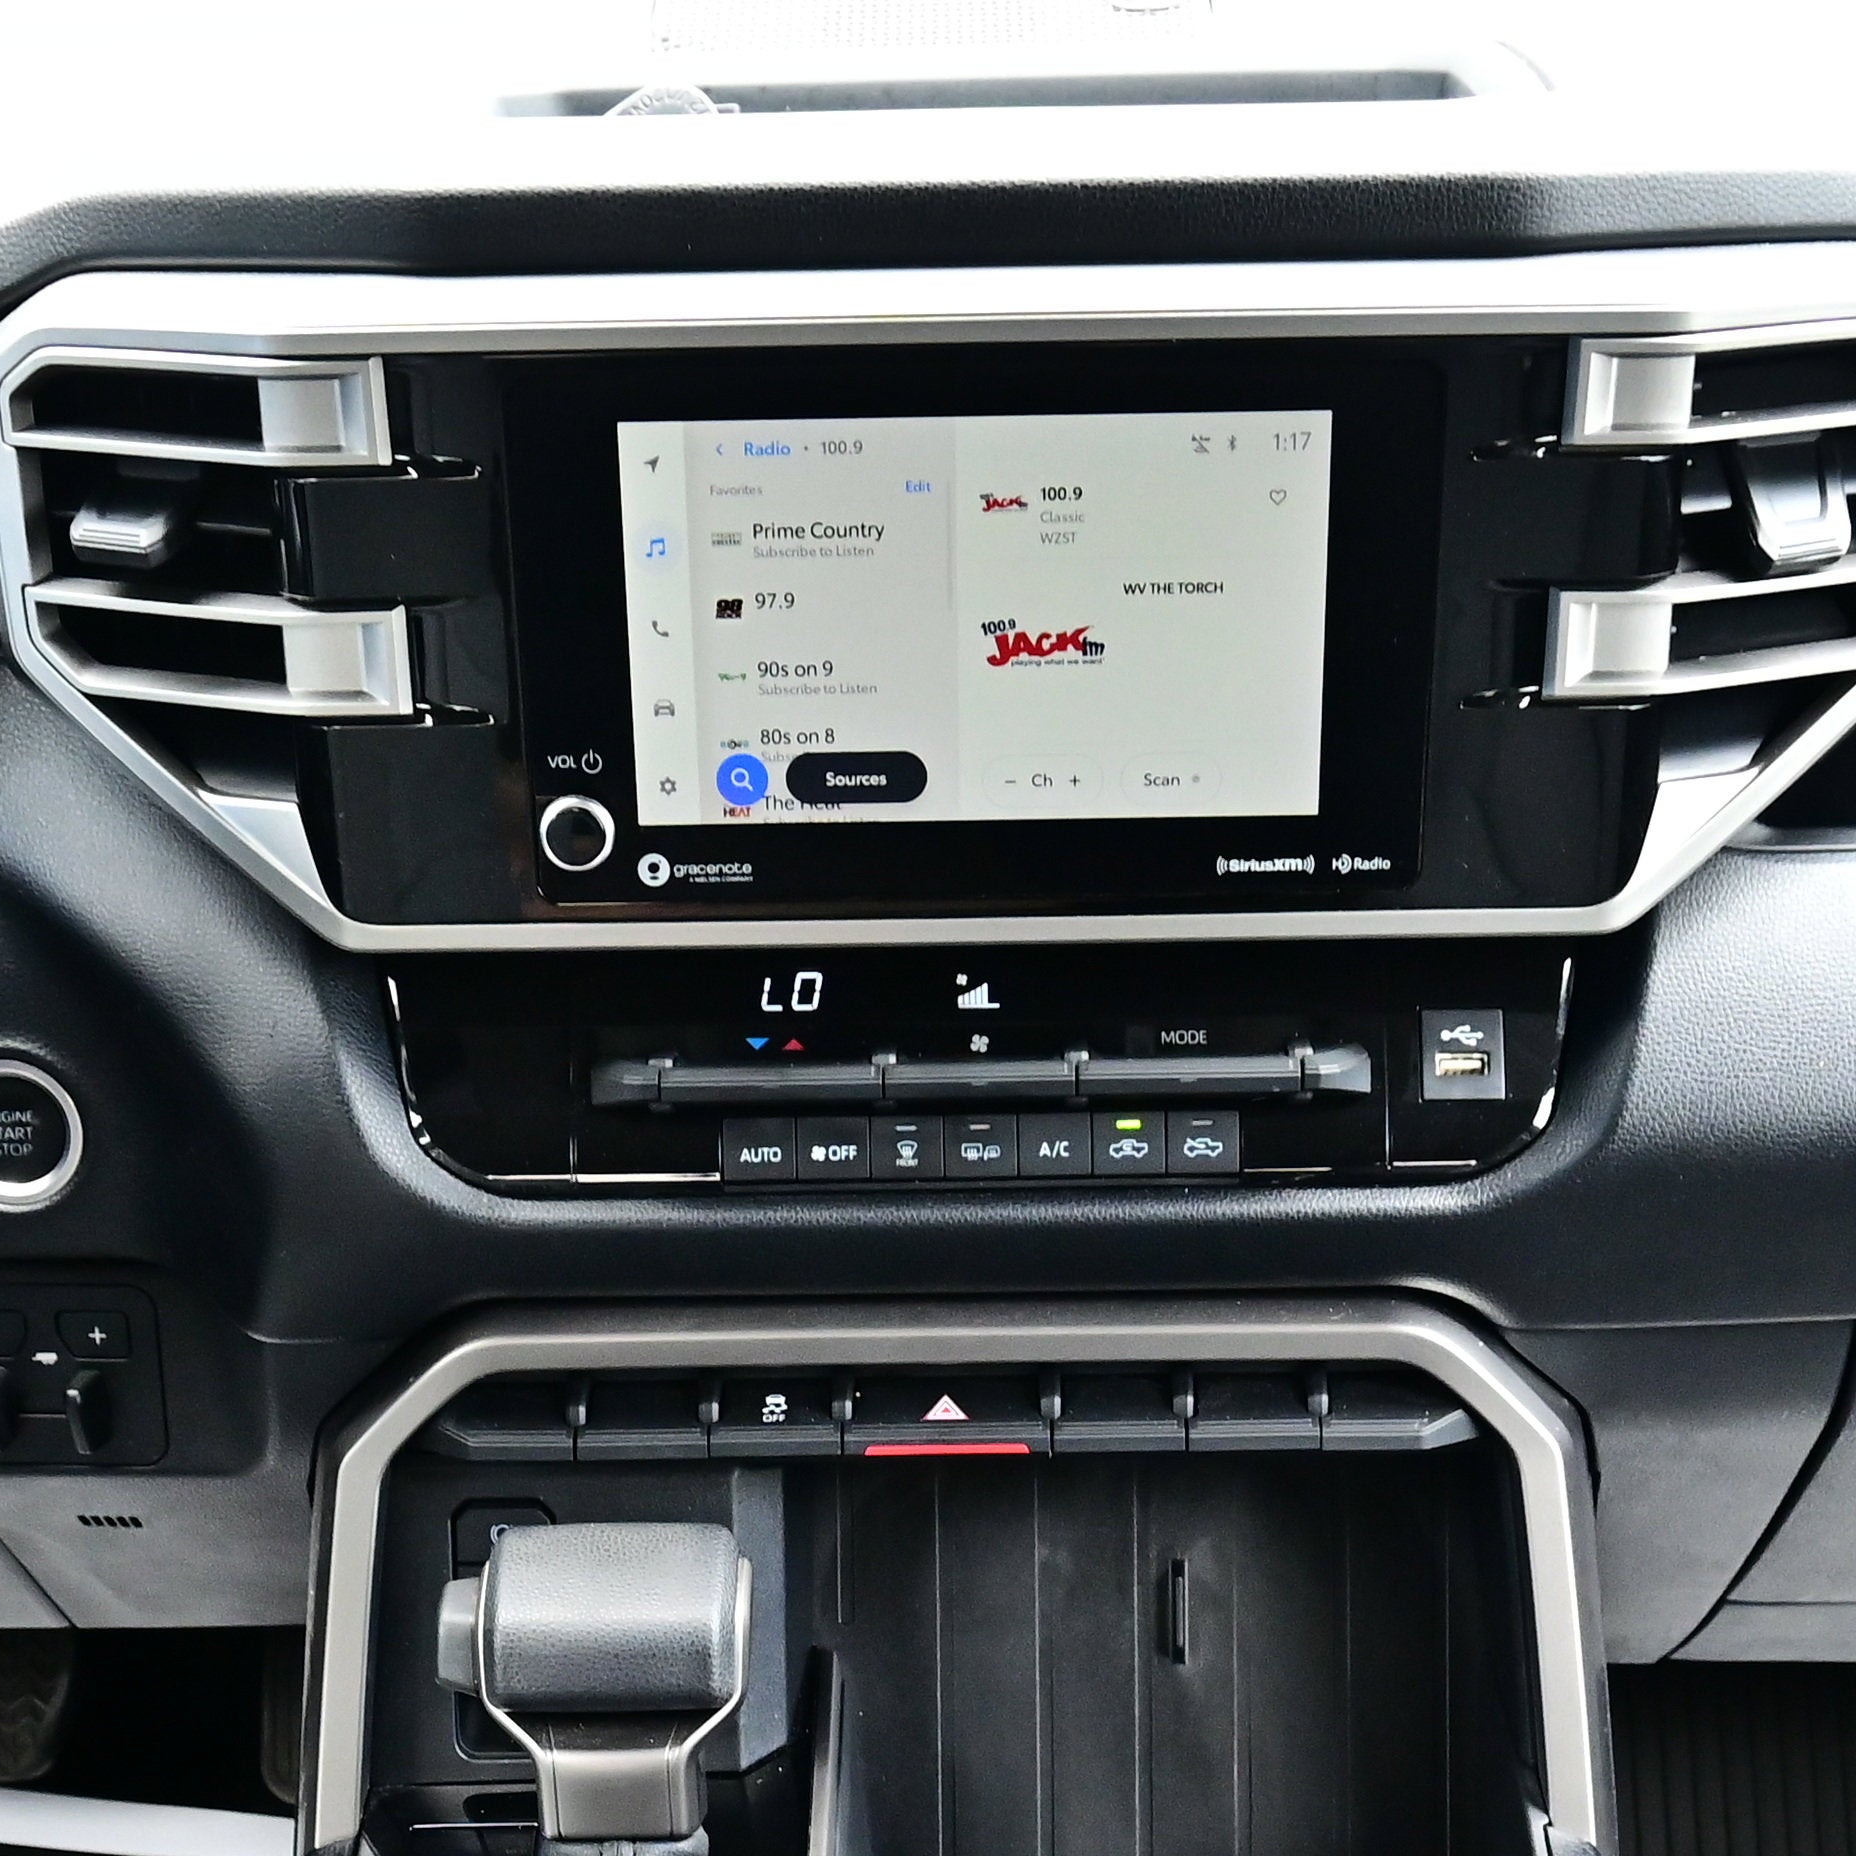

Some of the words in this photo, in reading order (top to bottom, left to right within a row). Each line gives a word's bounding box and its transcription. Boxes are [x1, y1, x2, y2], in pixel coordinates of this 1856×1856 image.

[743, 441, 792, 457] Radio
[821, 440, 864, 456] 100.9
[1272, 431, 1312, 452] 1:17
[709, 484, 764, 496] Favorites
[905, 480, 932, 494] Edit
[1040, 486, 1084, 502] 100.9
[1039, 511, 1086, 524] Classic
[752, 521, 806, 540] Prime
[809, 520, 885, 541] Country
[752, 545, 818, 558] Subscribe
[819, 546, 833, 557] to
[835, 544, 875, 557] Listen
[1122, 582, 1147, 596] WV
[1150, 582, 1176, 595] THE
[1177, 581, 1225, 595] TORCH
[754, 592, 796, 610] 97.9
[981, 618, 1017, 637] 100.9
[986, 626, 1091, 667] JACK
[1081, 635, 1106, 657] fm
[757, 660, 789, 679] 90s
[794, 663, 818, 678] on
[822, 660, 834, 677] 9
[757, 684, 822, 696] Subscribe
[823, 684, 837, 695] to
[839, 682, 878, 695] Listen
[760, 728, 792, 746] 80s
[796, 730, 820, 745] on
[824, 727, 836, 745] 8
[547, 754, 578, 770] VOL
[825, 771, 888, 788] Sources
[1031, 773, 1054, 789] Ch
[1143, 772, 1182, 788] Scan
[764, 793, 795, 811] The
[673, 861, 753, 878] gracenote
[1353, 855, 1392, 871] Radio
[760, 970, 824, 1013] LO
[1160, 1029, 1208, 1046] MODE
[739, 1146, 782, 1164] AUTO
[827, 1144, 858, 1162] OFF
[1039, 1141, 1070, 1159] A/C
[762, 1413, 786, 1423] OFF
